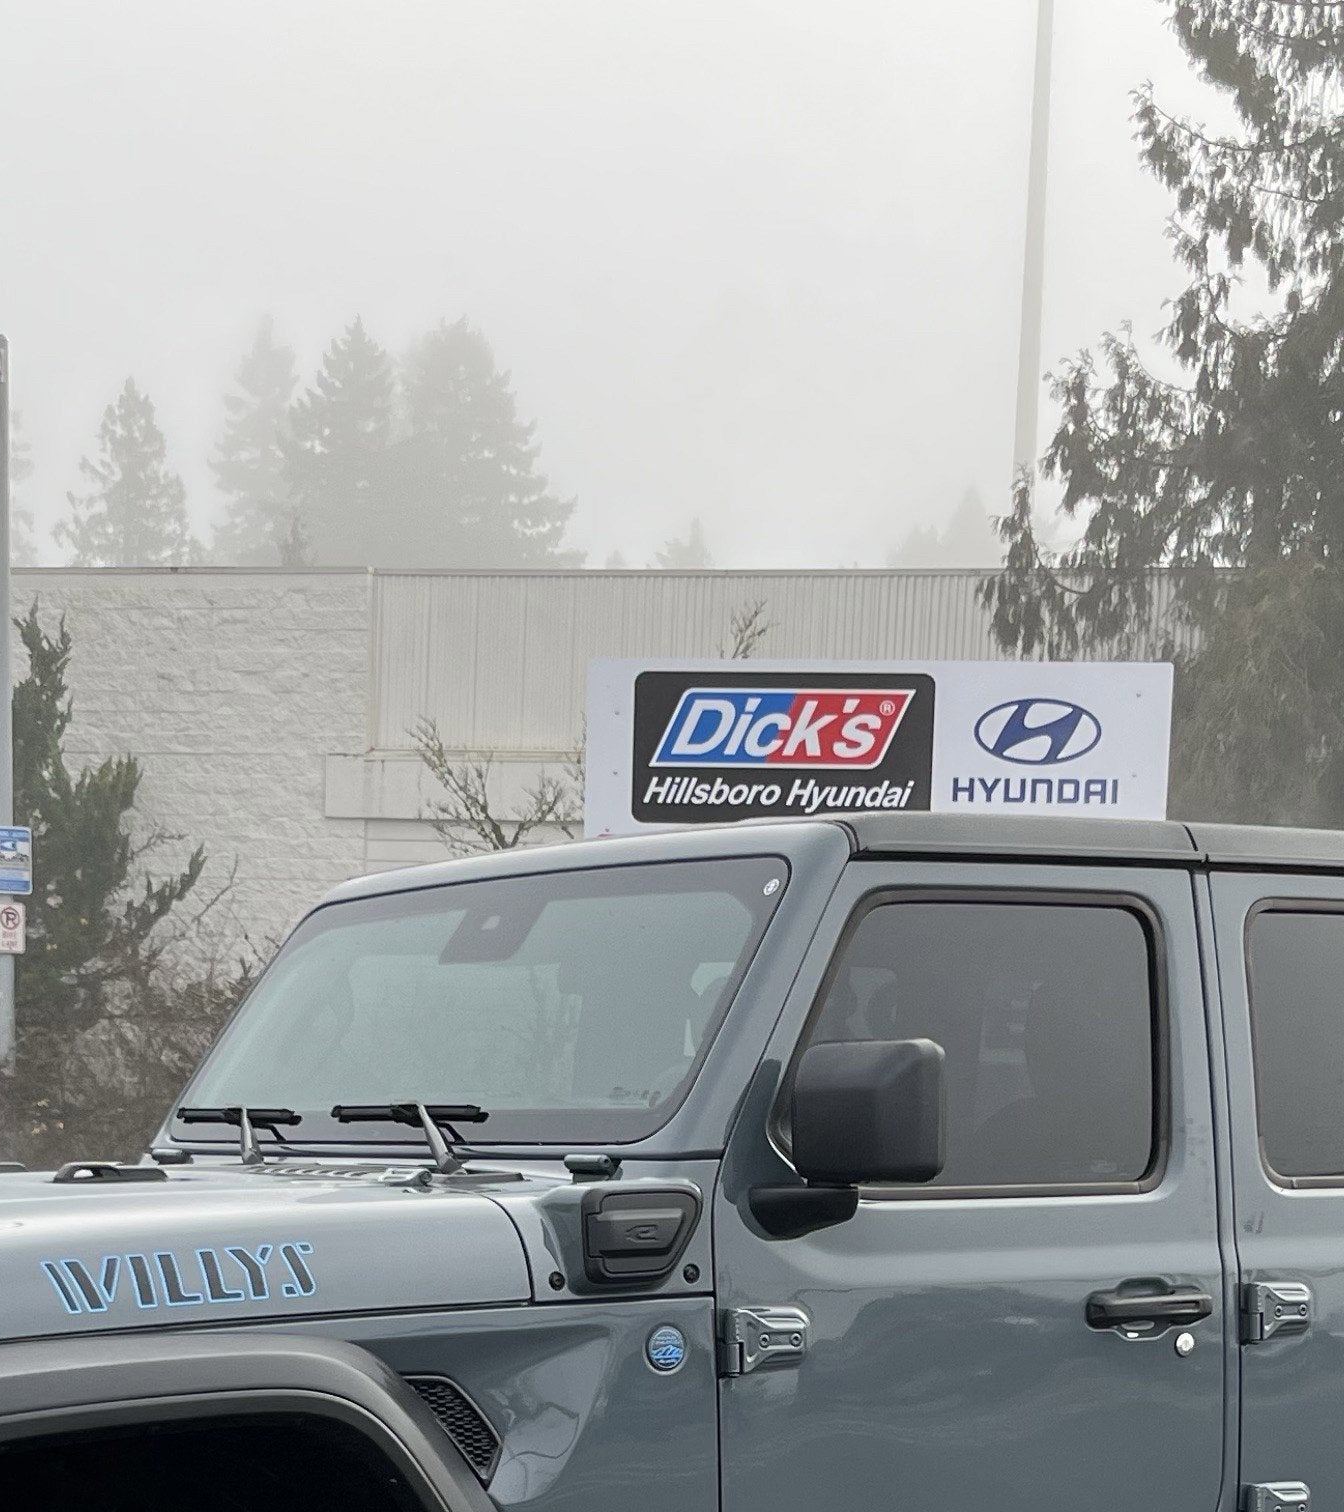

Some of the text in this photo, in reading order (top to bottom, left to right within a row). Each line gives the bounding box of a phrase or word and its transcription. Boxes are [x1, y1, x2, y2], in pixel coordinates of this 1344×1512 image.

[670, 697, 882, 758] Dick's
[642, 776, 915, 814] Hillsboro Hyundai
[951, 776, 1120, 805] HYUNDAI
[40, 1243, 317, 1314] WILLYS
